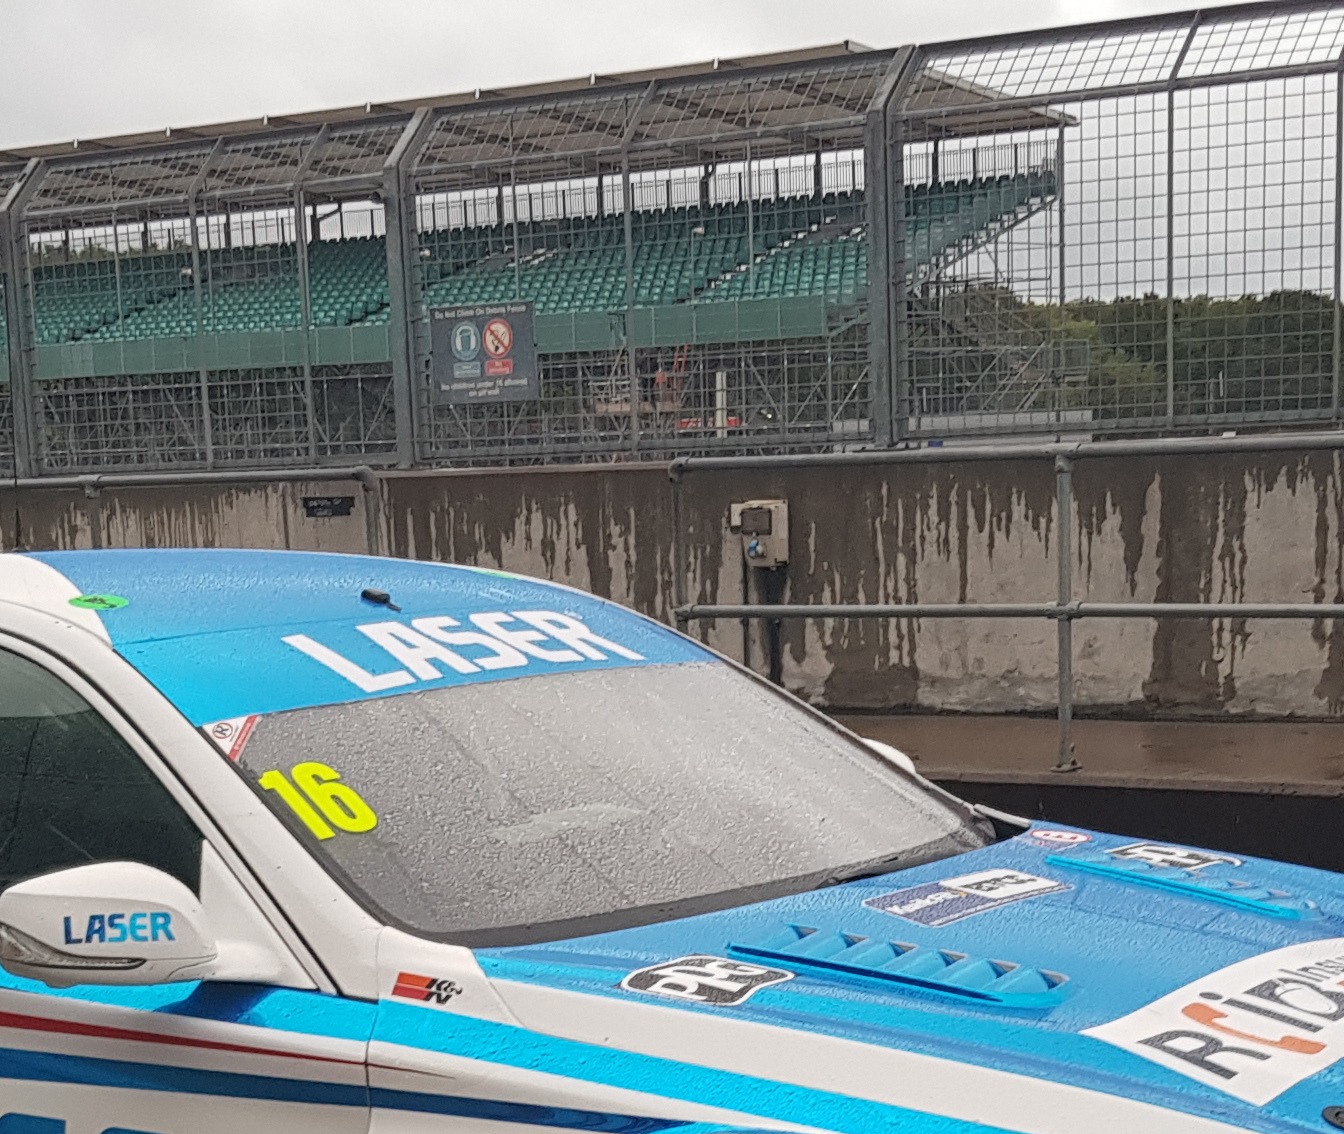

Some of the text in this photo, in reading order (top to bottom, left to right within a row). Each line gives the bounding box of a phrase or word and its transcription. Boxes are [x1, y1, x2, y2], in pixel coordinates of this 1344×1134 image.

[281, 610, 646, 693] LASER
[258, 761, 378, 840] 16
[63, 911, 176, 945] LASER
